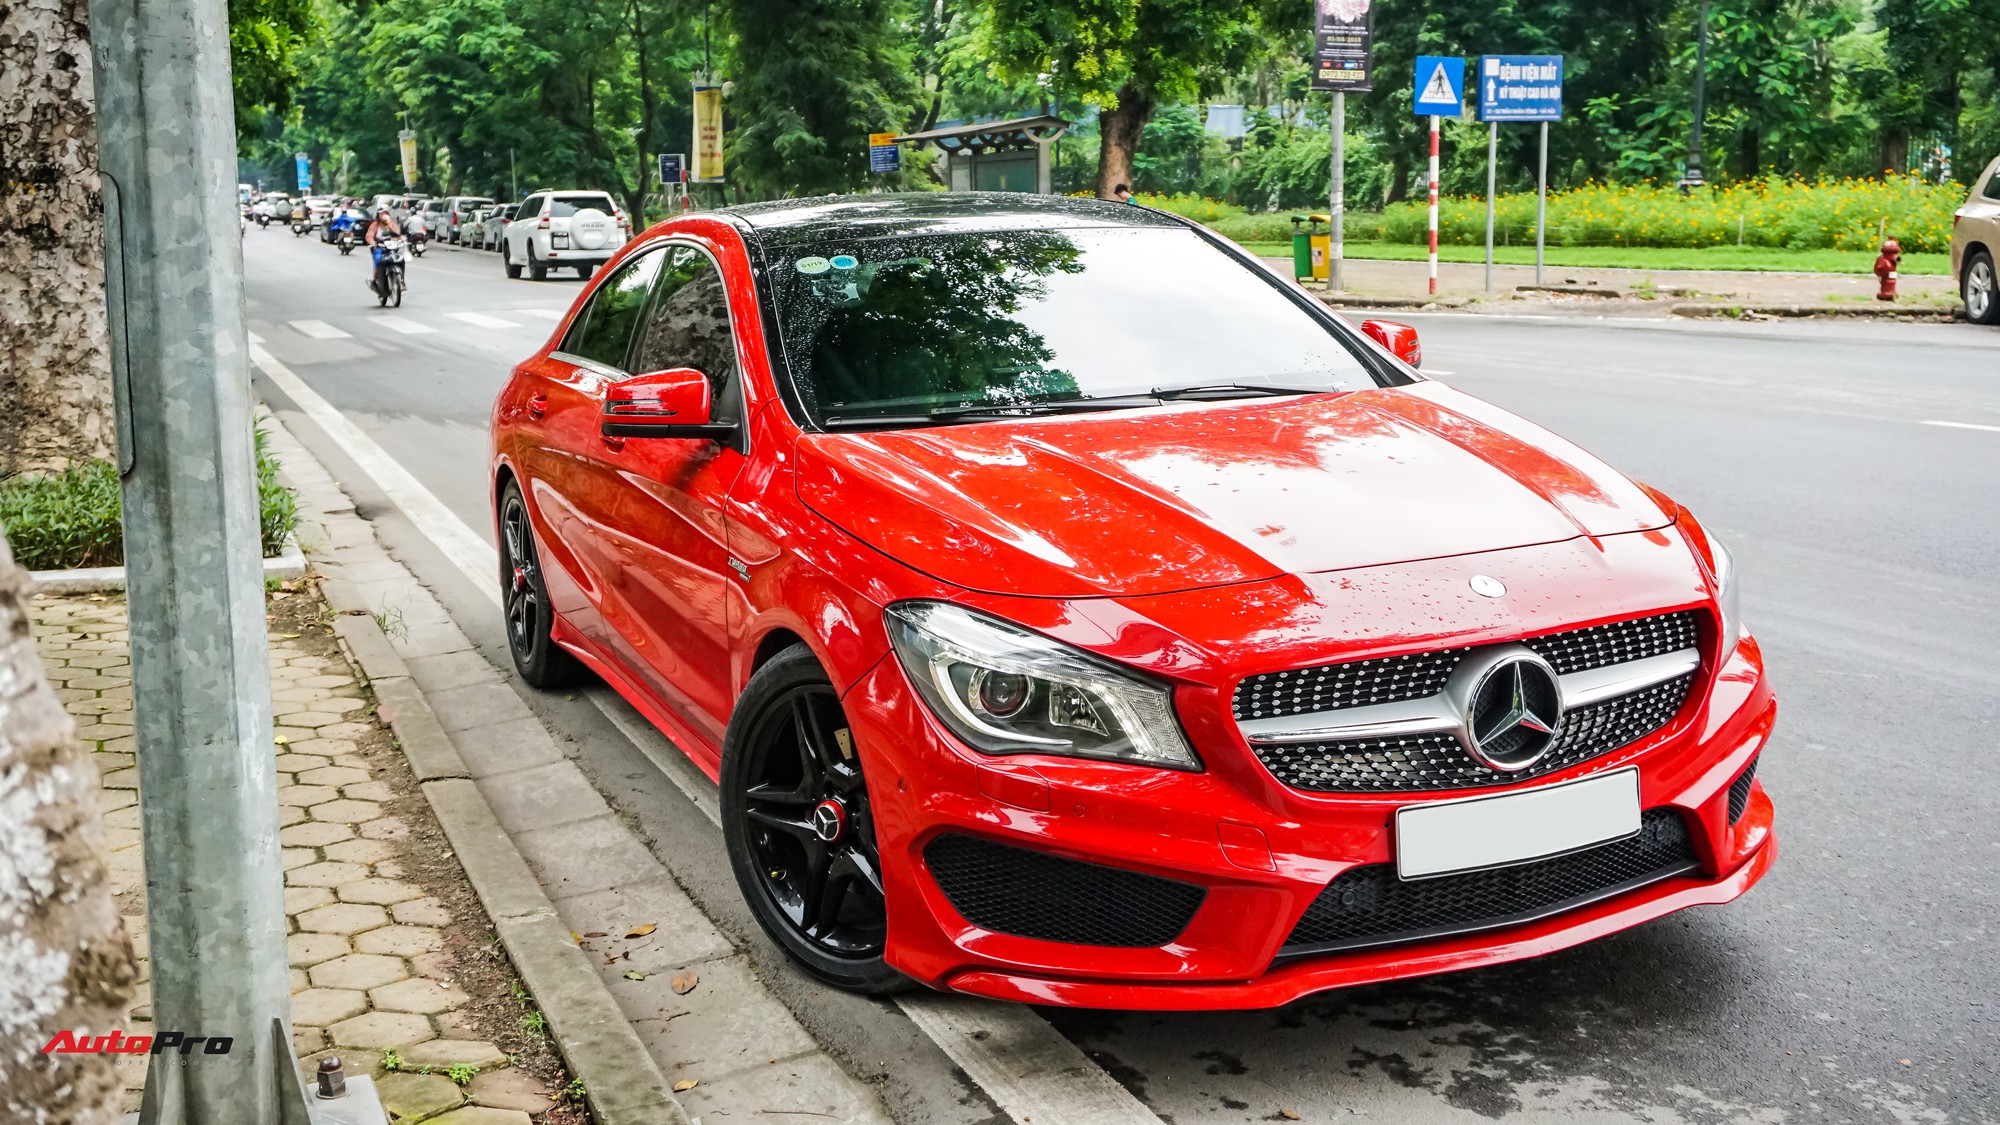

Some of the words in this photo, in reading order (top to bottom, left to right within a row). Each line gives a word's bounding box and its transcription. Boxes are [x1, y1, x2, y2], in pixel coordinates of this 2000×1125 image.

[1500, 63, 1520, 82] BỆNH
[1522, 63, 1540, 82] VIỆN
[1540, 61, 1557, 80] MẮT
[1509, 85, 1527, 100] THUẬT
[1528, 87, 1540, 98] CAO
